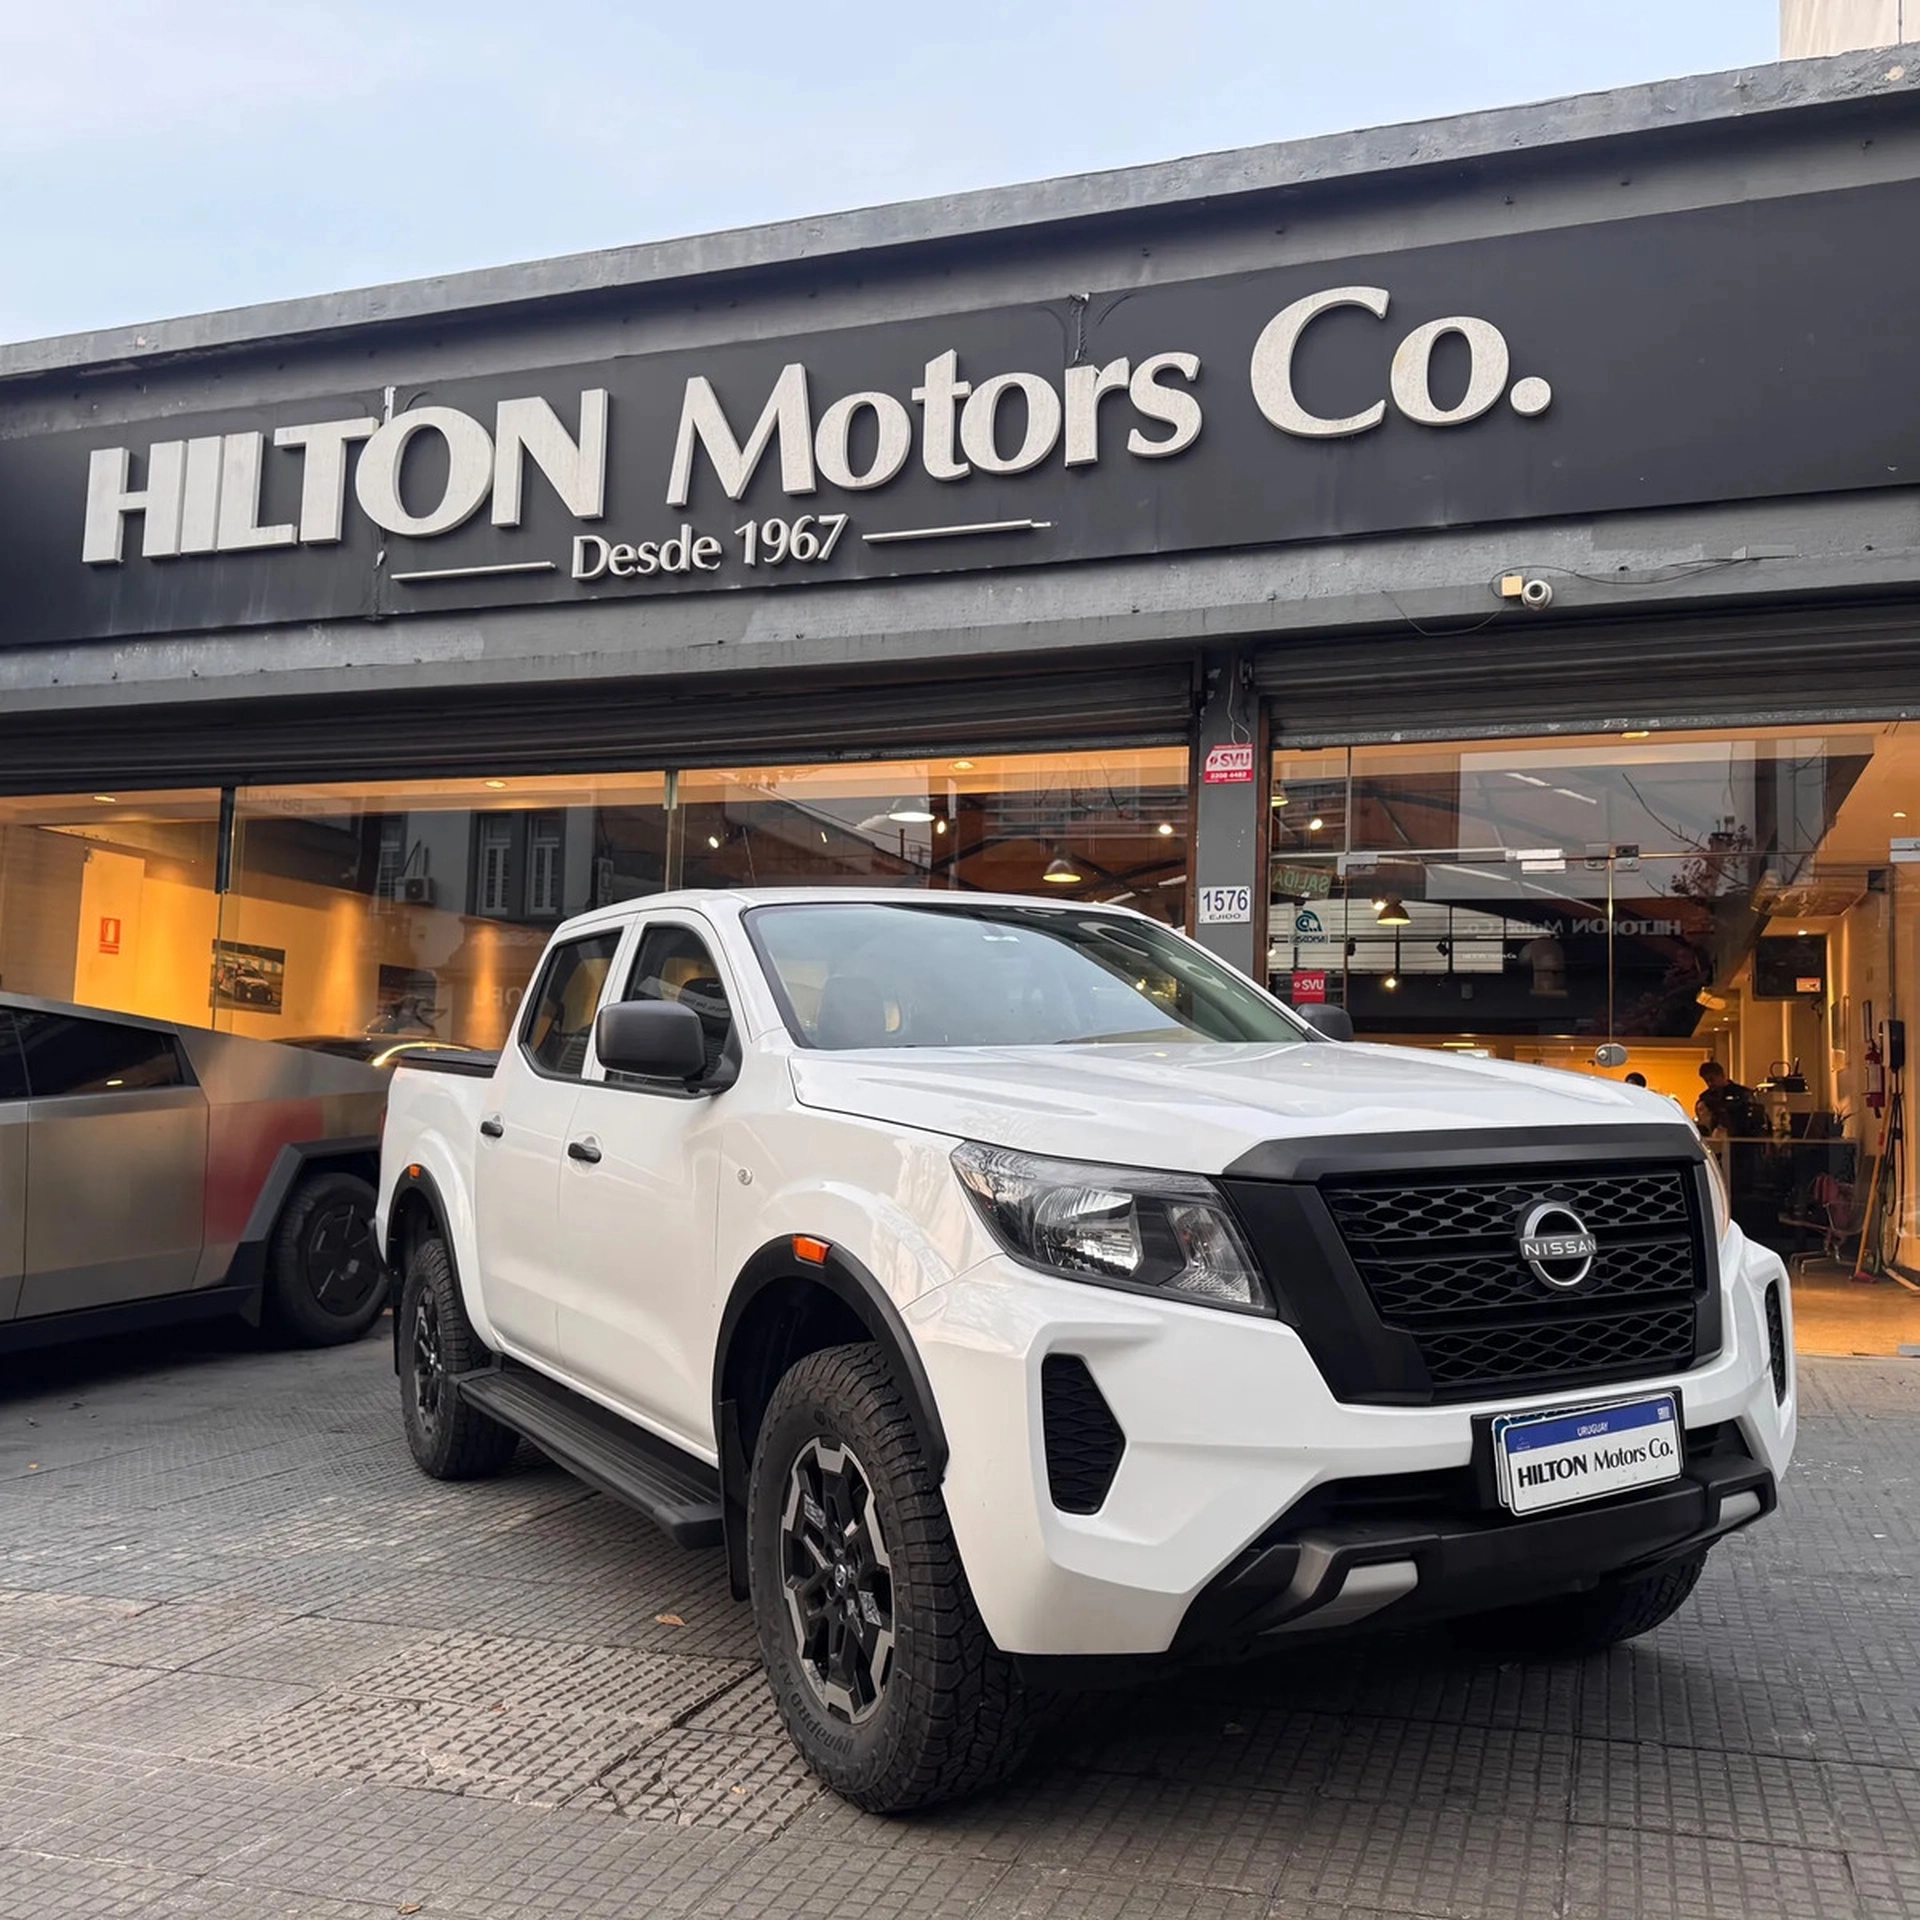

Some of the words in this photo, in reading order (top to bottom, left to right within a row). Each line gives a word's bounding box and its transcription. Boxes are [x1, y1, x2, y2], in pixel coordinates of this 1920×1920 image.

[82, 388, 609, 564] HILTON
[665, 349, 1203, 506] Motors
[1250, 286, 1553, 441] Co.
[571, 524, 721, 579] Desde
[734, 513, 848, 566] 1967
[1220, 752, 1250, 767] SVU
[1202, 890, 1249, 912] 1576
[1208, 911, 1242, 922] EJIDO
[1302, 979, 1324, 991] SVU
[1524, 1240, 1596, 1256] NISSAN
[1576, 1421, 1609, 1438] URUGUAY
[1517, 1454, 1588, 1488] HILTON
[1593, 1445, 1647, 1473] Motors
[1648, 1437, 1674, 1458] Co.
